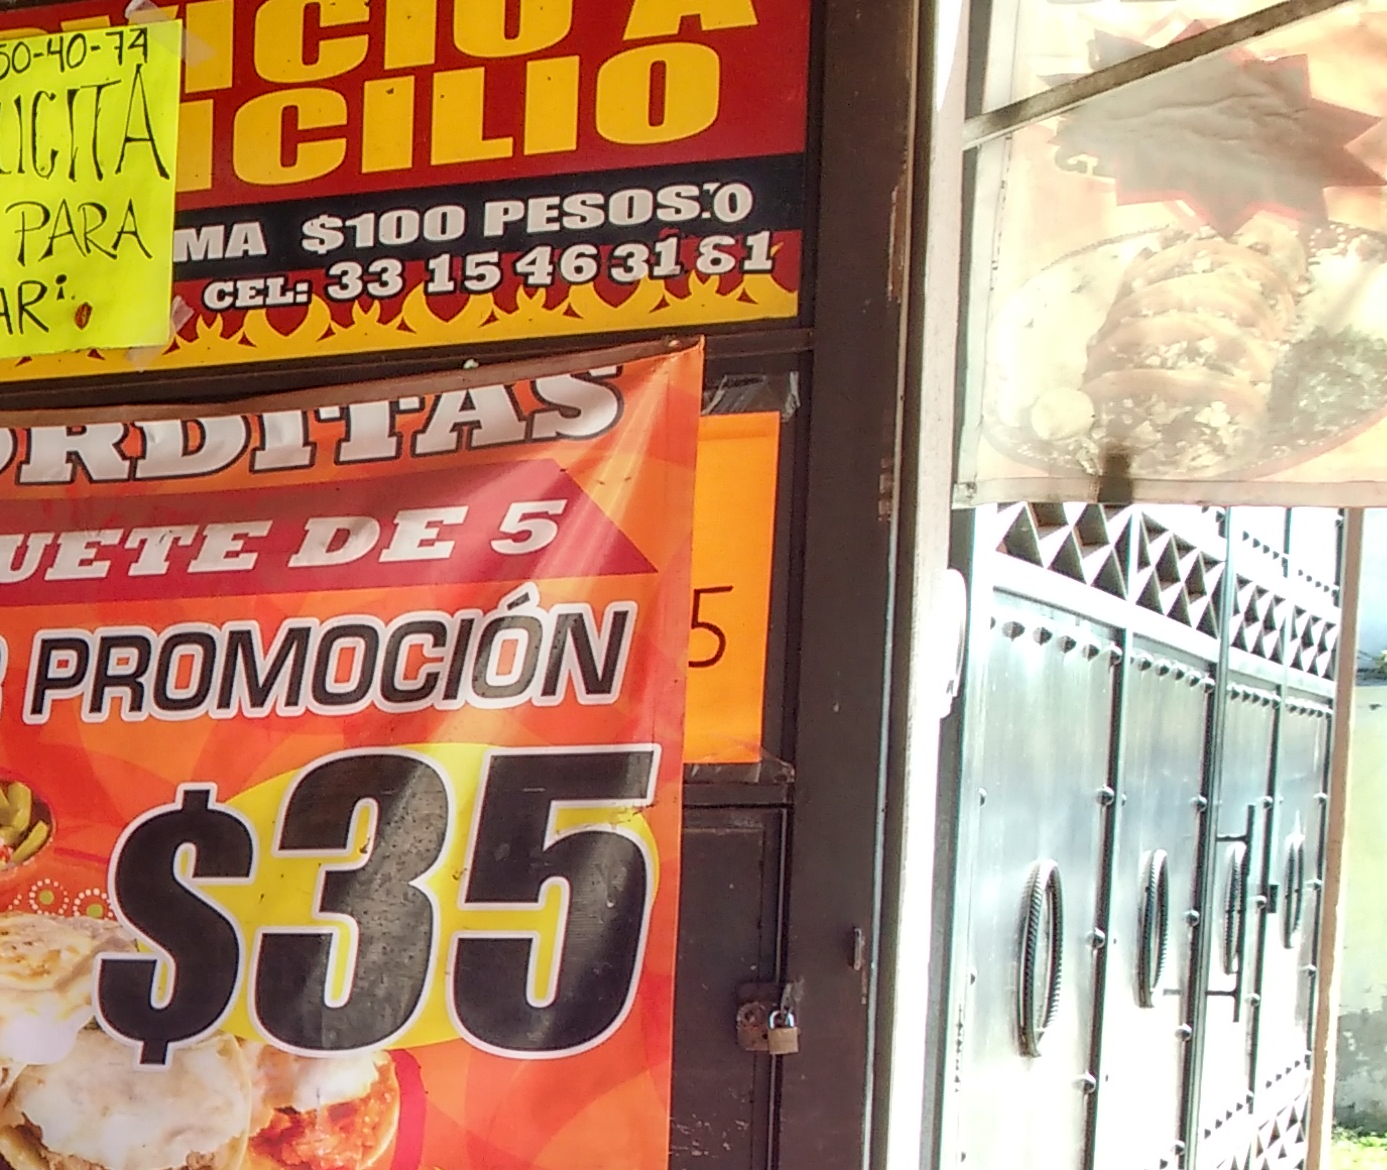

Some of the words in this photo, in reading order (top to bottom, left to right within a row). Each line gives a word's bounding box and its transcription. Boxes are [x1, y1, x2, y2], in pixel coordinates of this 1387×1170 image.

[177, 41, 722, 193] ICILIO
[5, 199, 153, 266] PARA
[172, 221, 268, 262] MA
[302, 204, 467, 254] $100
[203, 277, 310, 310] CEL:
[287, 504, 467, 571] DE
[490, 499, 569, 556] 5
[23, 583, 639, 729] PROMOCIÓN
[93, 742, 662, 1071] $35
